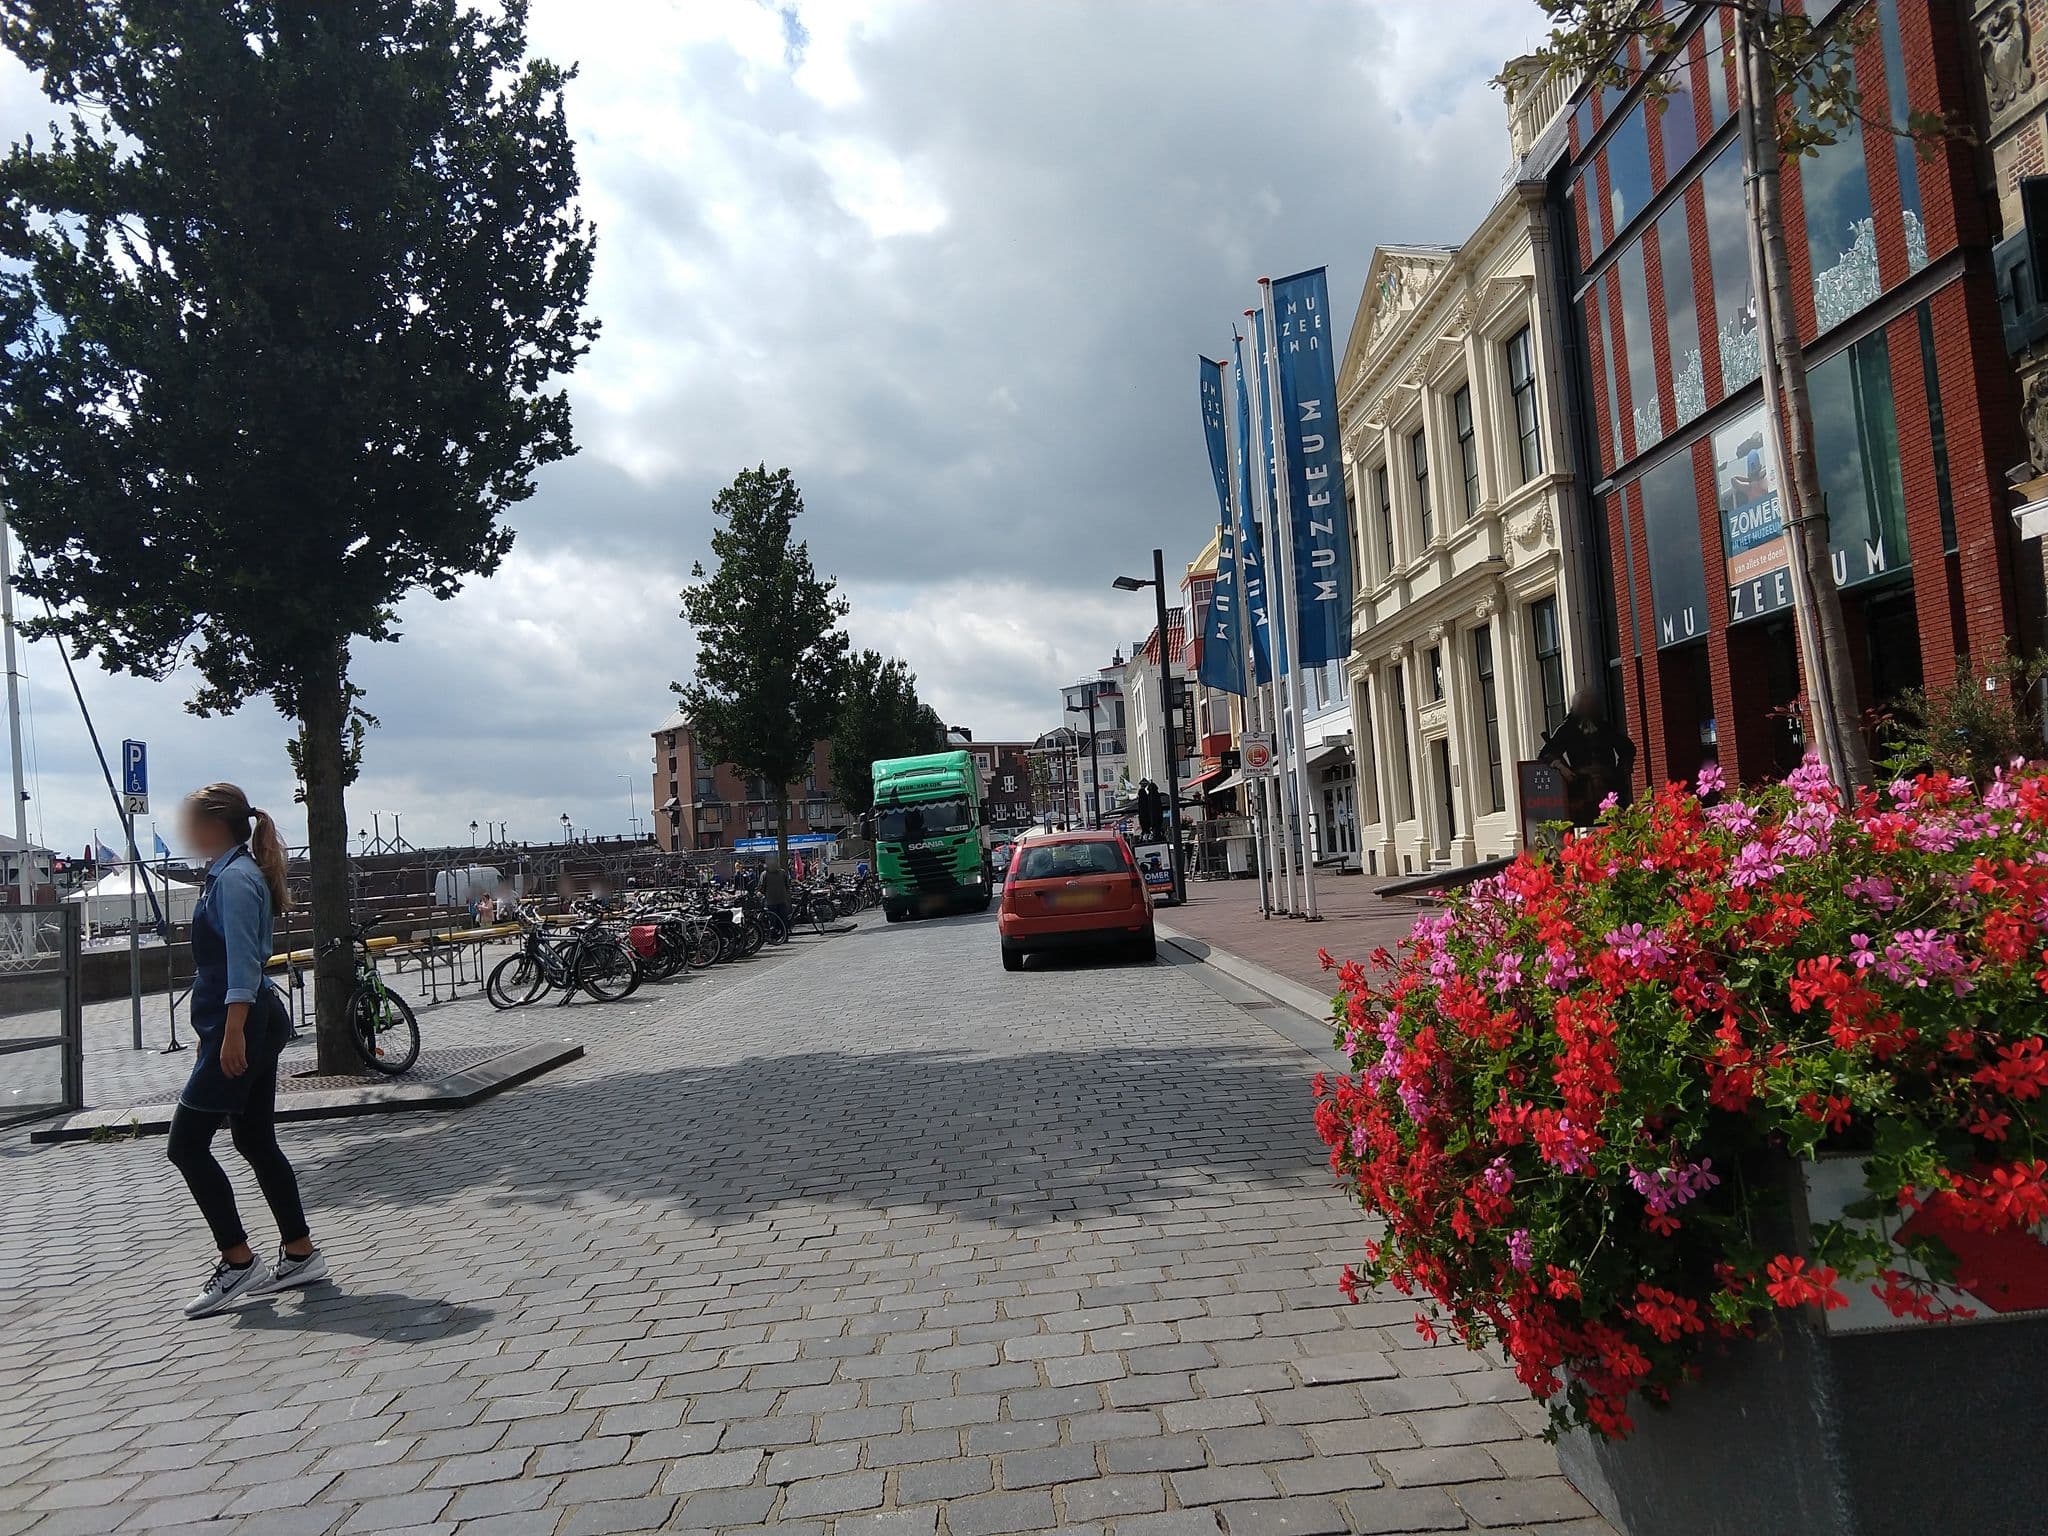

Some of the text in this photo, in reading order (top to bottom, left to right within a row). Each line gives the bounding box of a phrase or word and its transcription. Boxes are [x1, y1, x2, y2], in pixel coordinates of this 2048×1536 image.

[1287, 297, 1315, 315] MU
[1283, 315, 1321, 336] ZEE
[1298, 399, 1338, 601] MUZEEUM
[1730, 497, 1781, 538] ZOMER
[1735, 563, 1746, 574] van
[1746, 556, 1760, 570] alles
[1760, 554, 1767, 563] te
[1662, 537, 1885, 644] MU ZEE UM
[130, 745, 142, 771] P
[129, 797, 145, 812] 2x
[908, 840, 944, 851] SCANIA
[1145, 871, 1169, 880] OMER
